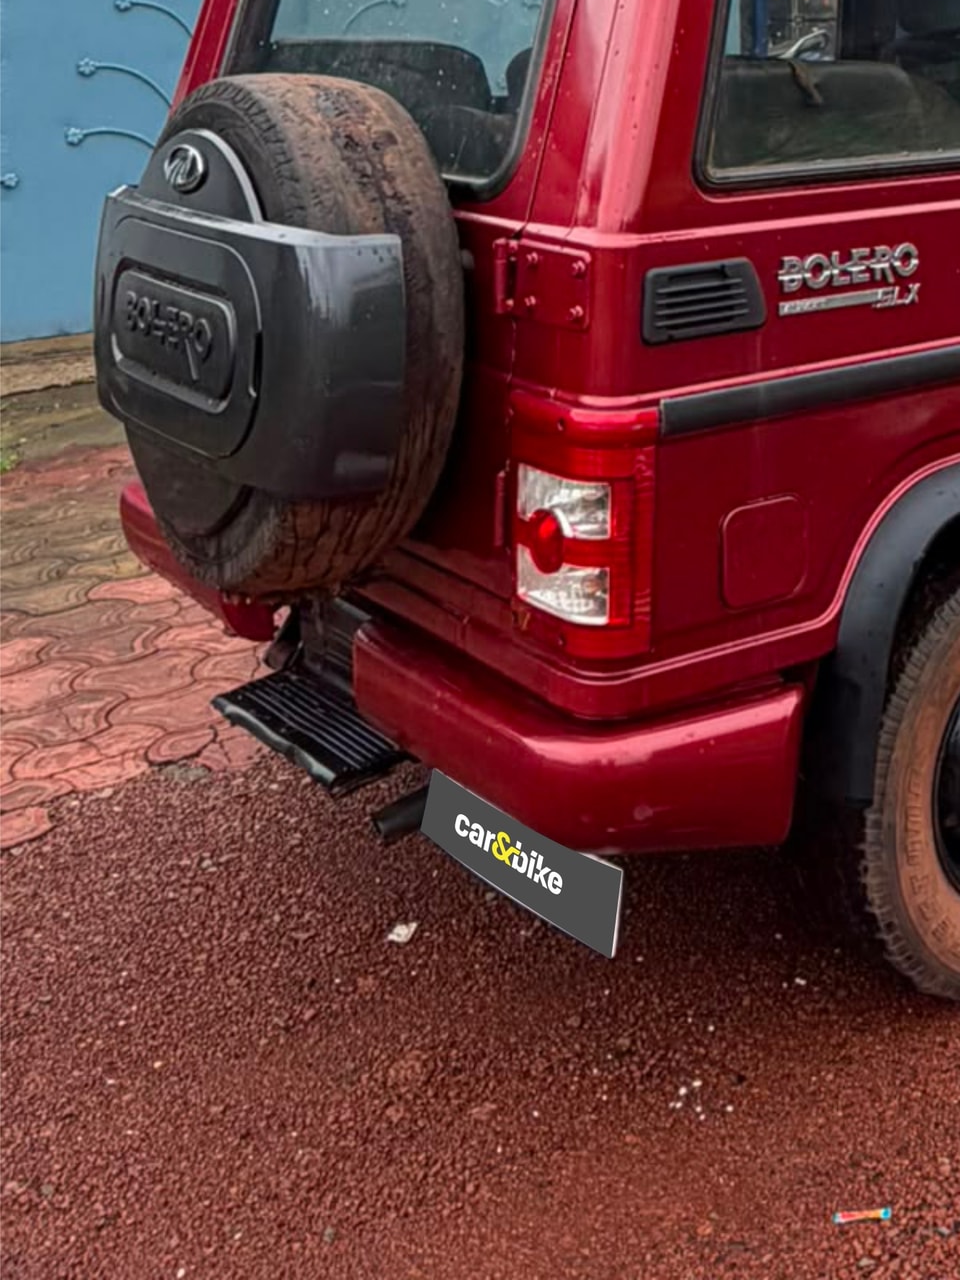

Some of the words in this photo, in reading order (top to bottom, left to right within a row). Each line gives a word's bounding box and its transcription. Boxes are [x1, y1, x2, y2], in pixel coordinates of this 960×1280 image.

[778, 242, 919, 293] BOLERO
[871, 283, 921, 308] SLX
[126, 290, 213, 380] BOLERO
